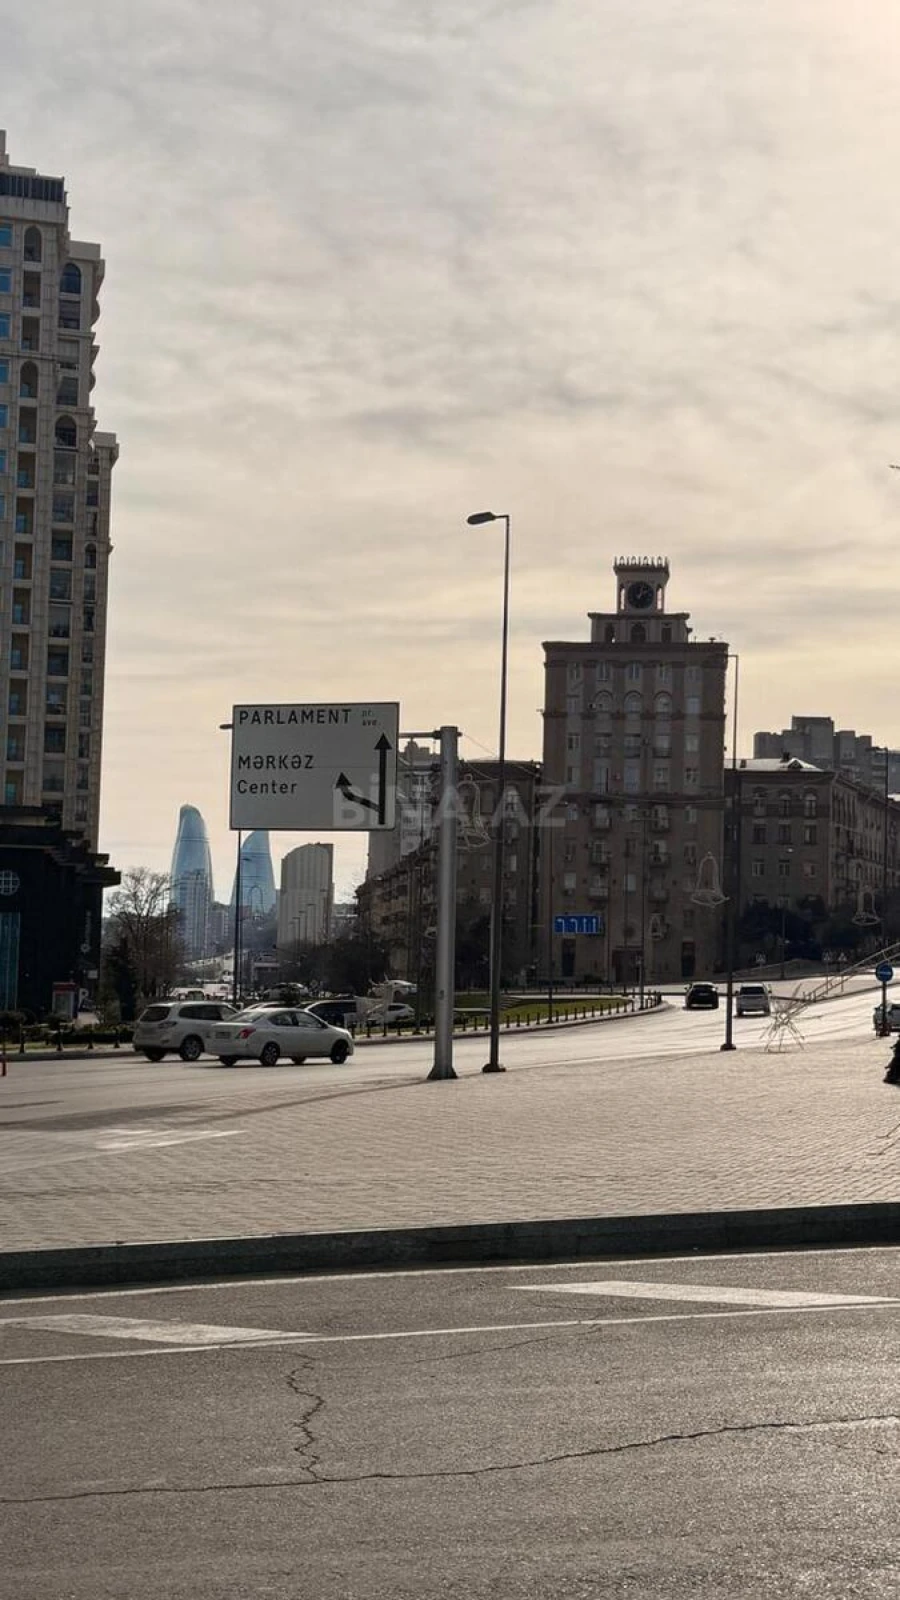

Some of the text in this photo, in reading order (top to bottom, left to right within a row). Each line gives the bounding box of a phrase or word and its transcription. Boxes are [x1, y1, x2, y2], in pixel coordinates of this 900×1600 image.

[239, 708, 352, 725] PARLAMENT
[238, 755, 314, 769] MƏRKƏZ
[237, 779, 297, 794] Center
